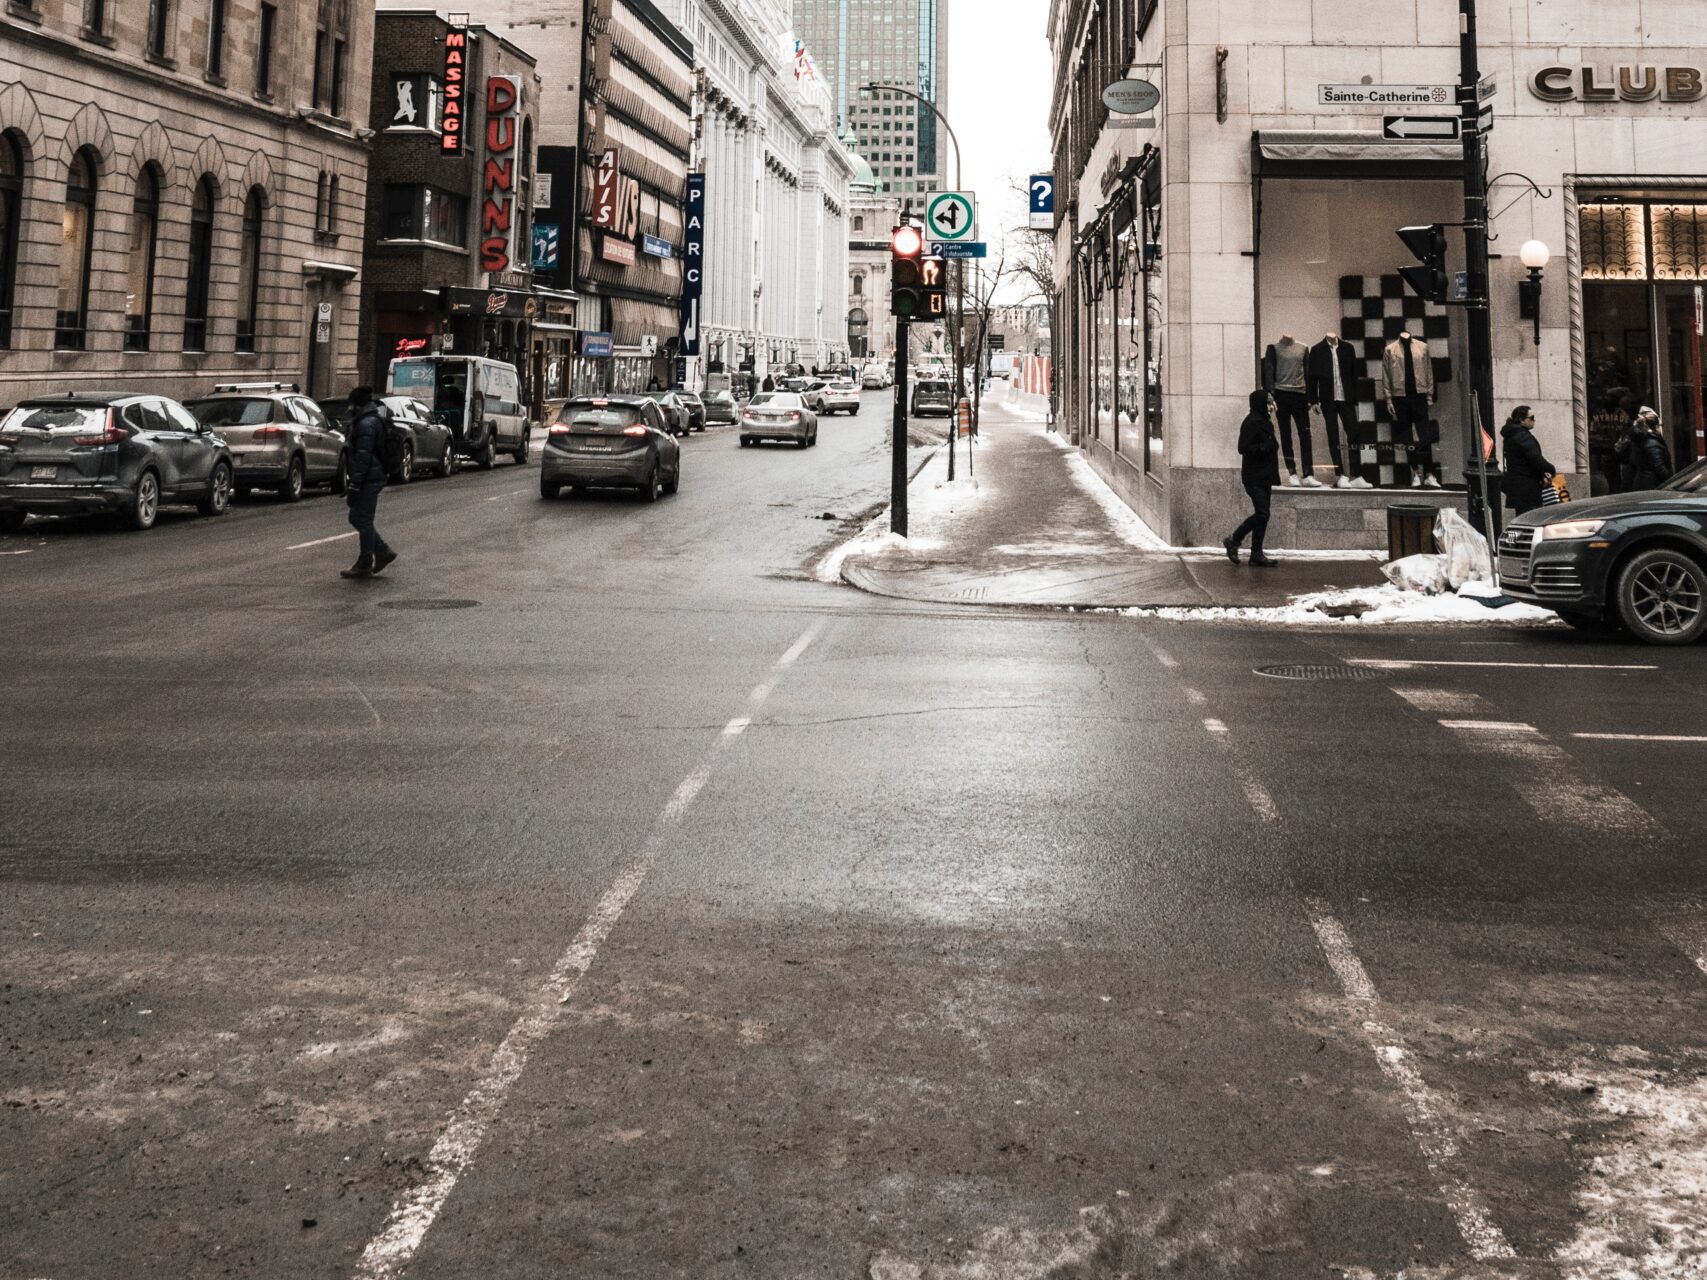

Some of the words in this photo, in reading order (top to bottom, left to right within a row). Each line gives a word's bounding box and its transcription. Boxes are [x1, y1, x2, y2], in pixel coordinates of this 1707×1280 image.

[443, 33, 464, 149] MASSAGE
[1324, 91, 1430, 102] Sainte-Catherine
[1534, 67, 1703, 95] CLUB
[481, 76, 517, 271] DUNNS
[597, 151, 614, 223] AVIS
[687, 189, 701, 282] PARC
